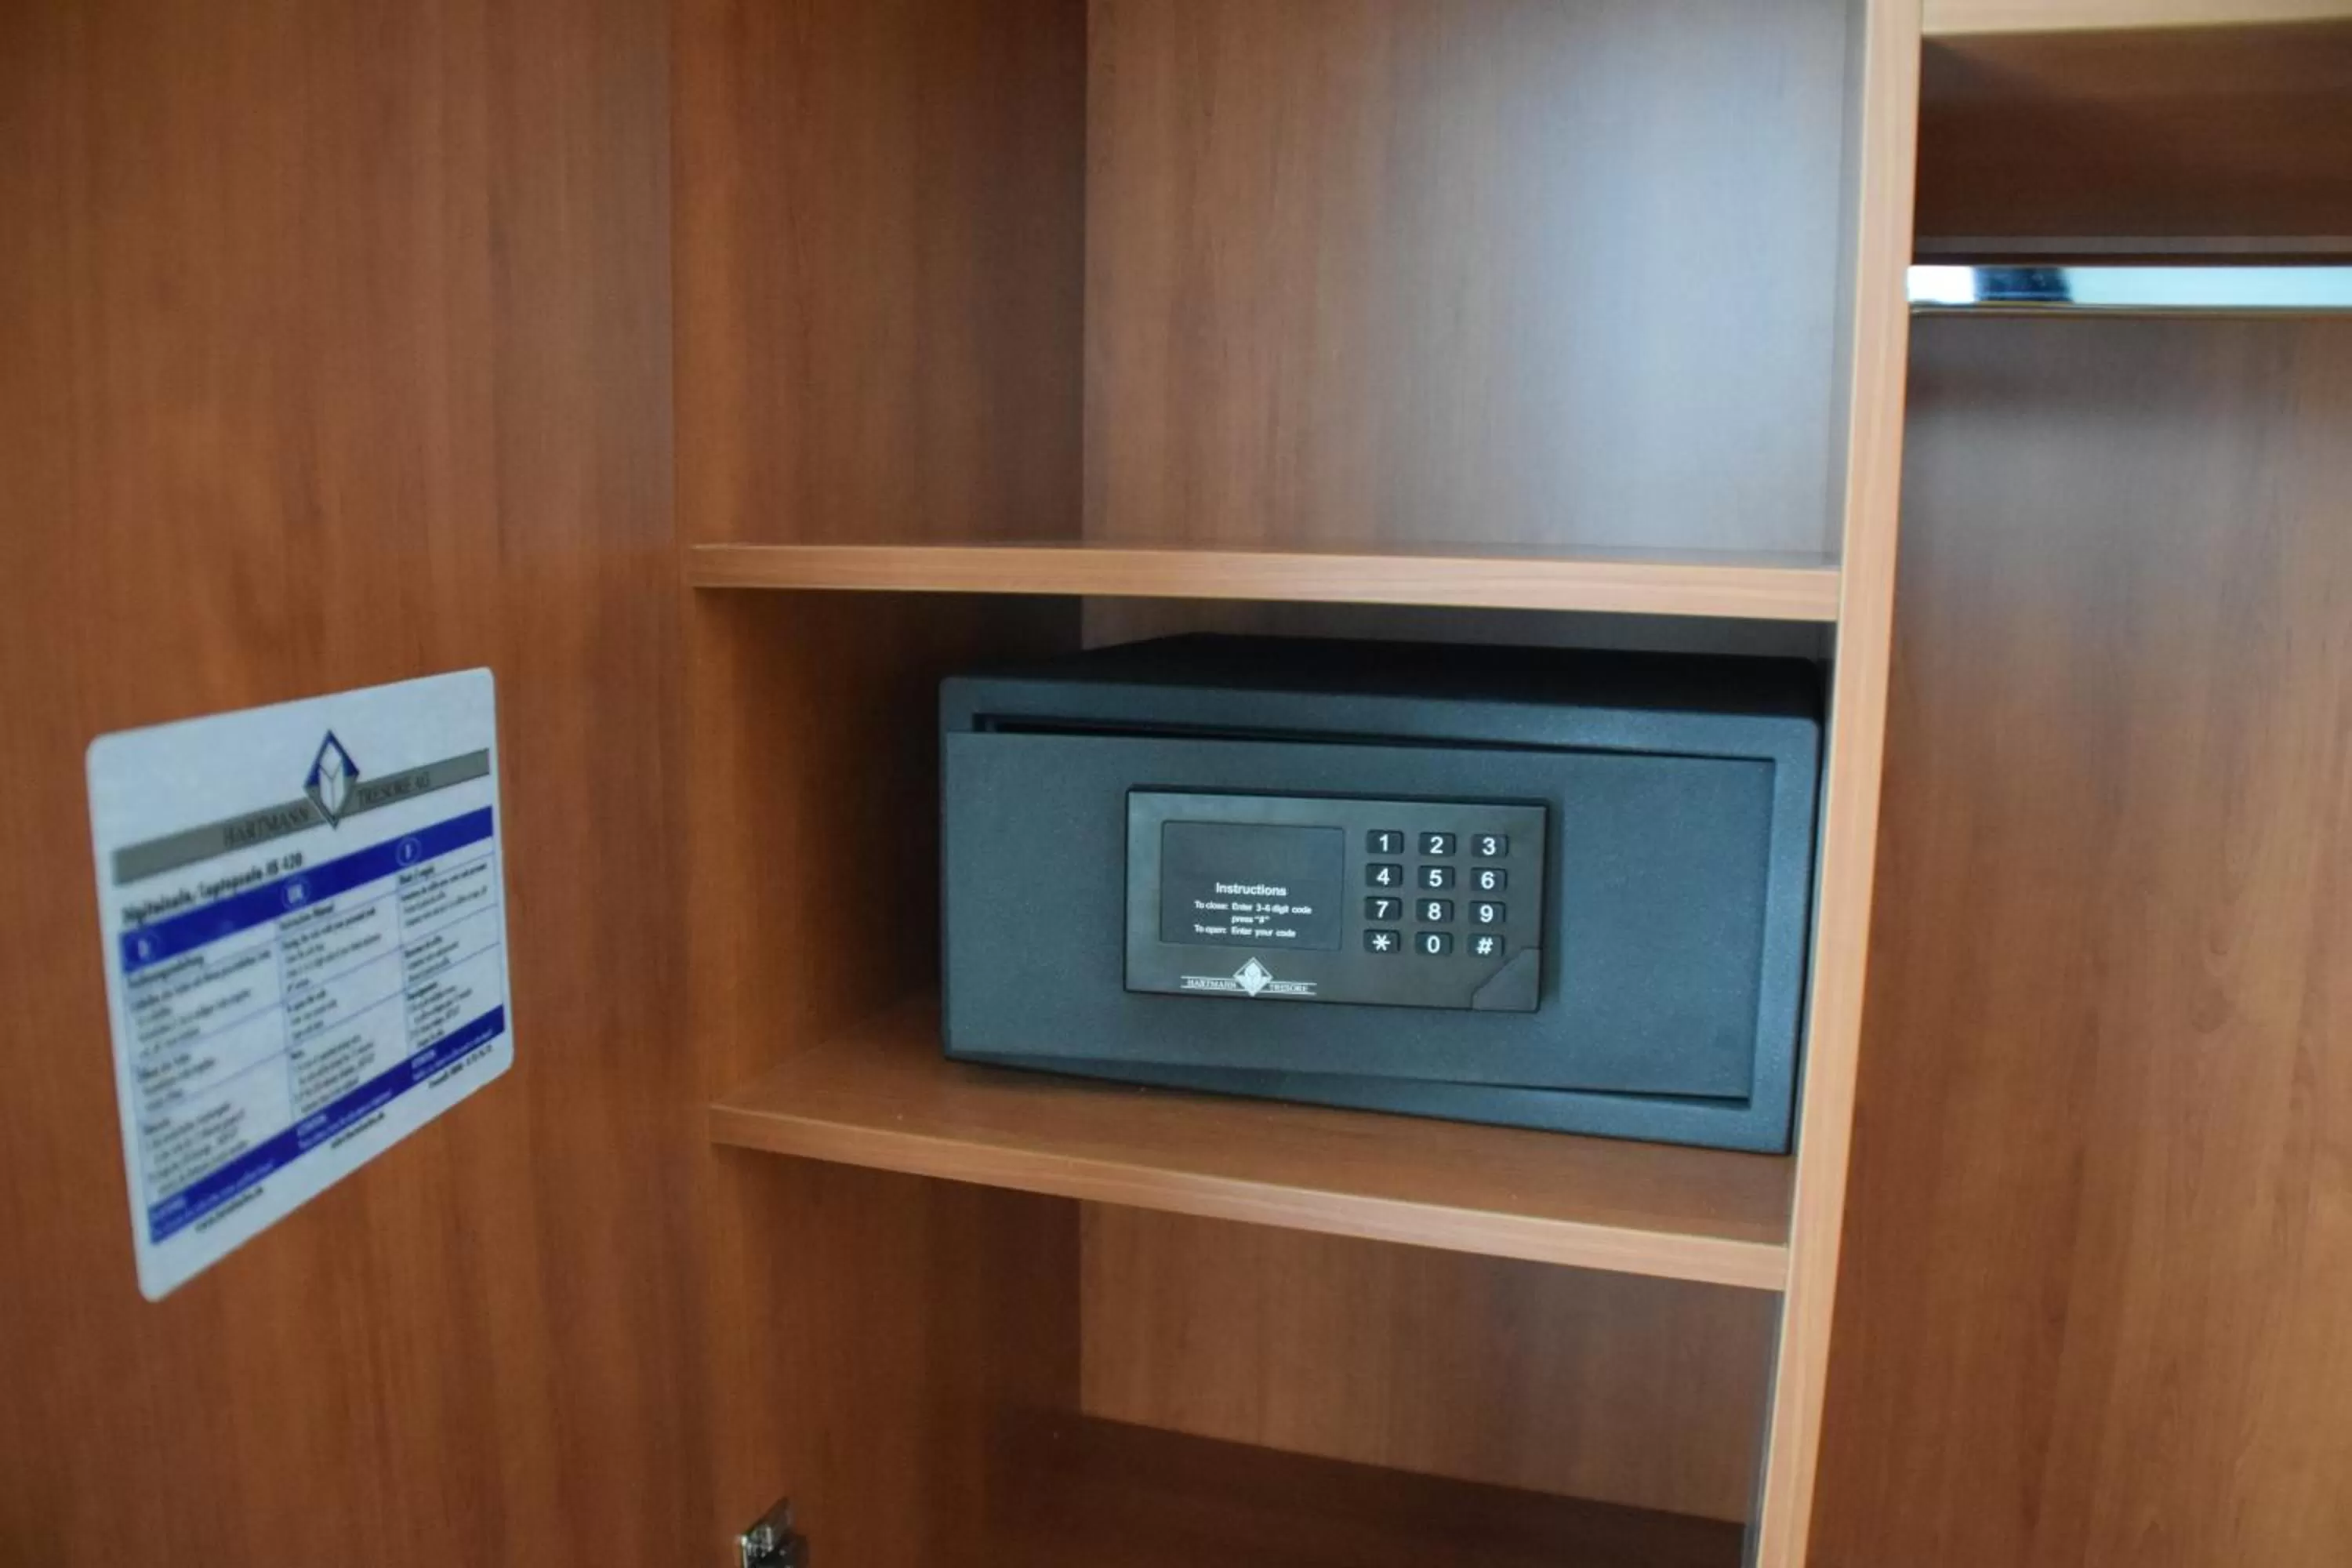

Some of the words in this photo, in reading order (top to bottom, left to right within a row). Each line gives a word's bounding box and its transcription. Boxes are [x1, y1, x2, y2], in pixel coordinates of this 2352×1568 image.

[1379, 834, 1388, 852] 1
[1430, 836, 1443, 854] 2
[1482, 837, 1496, 855] 3
[1216, 881, 1287, 896] Instructions
[1376, 868, 1390, 885] 4
[1429, 869, 1443, 887] 5
[1480, 871, 1495, 889] 6
[1291, 906, 1312, 915] code
[1376, 901, 1389, 919] 7
[1427, 902, 1442, 920] 8
[1479, 904, 1494, 923] 9
[1276, 928, 1297, 938] code
[1427, 935, 1441, 953] 0
[1475, 937, 1494, 955] #
